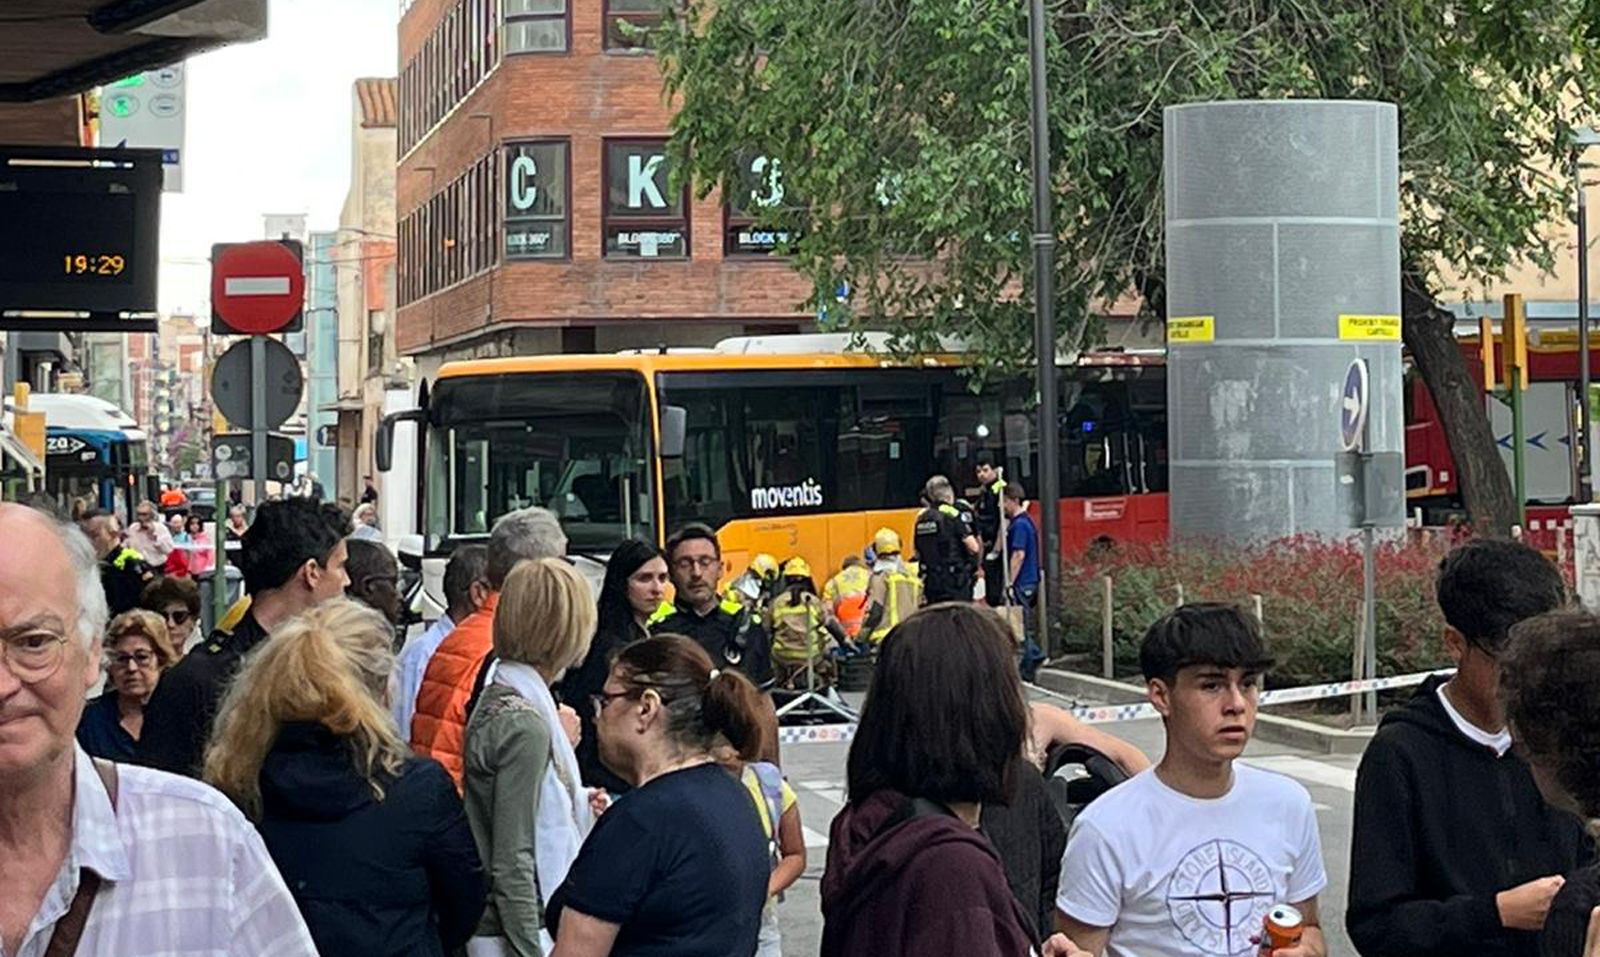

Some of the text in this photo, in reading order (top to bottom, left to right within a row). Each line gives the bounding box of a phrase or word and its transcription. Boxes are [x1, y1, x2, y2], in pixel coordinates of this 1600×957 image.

[511, 155, 537, 209] C
[628, 155, 667, 208] K
[739, 232, 775, 244] BLOCK
[64, 255, 124, 274] 19:29
[751, 477, 823, 509] moventis
[1175, 846, 1270, 893] STONE ISLAND
